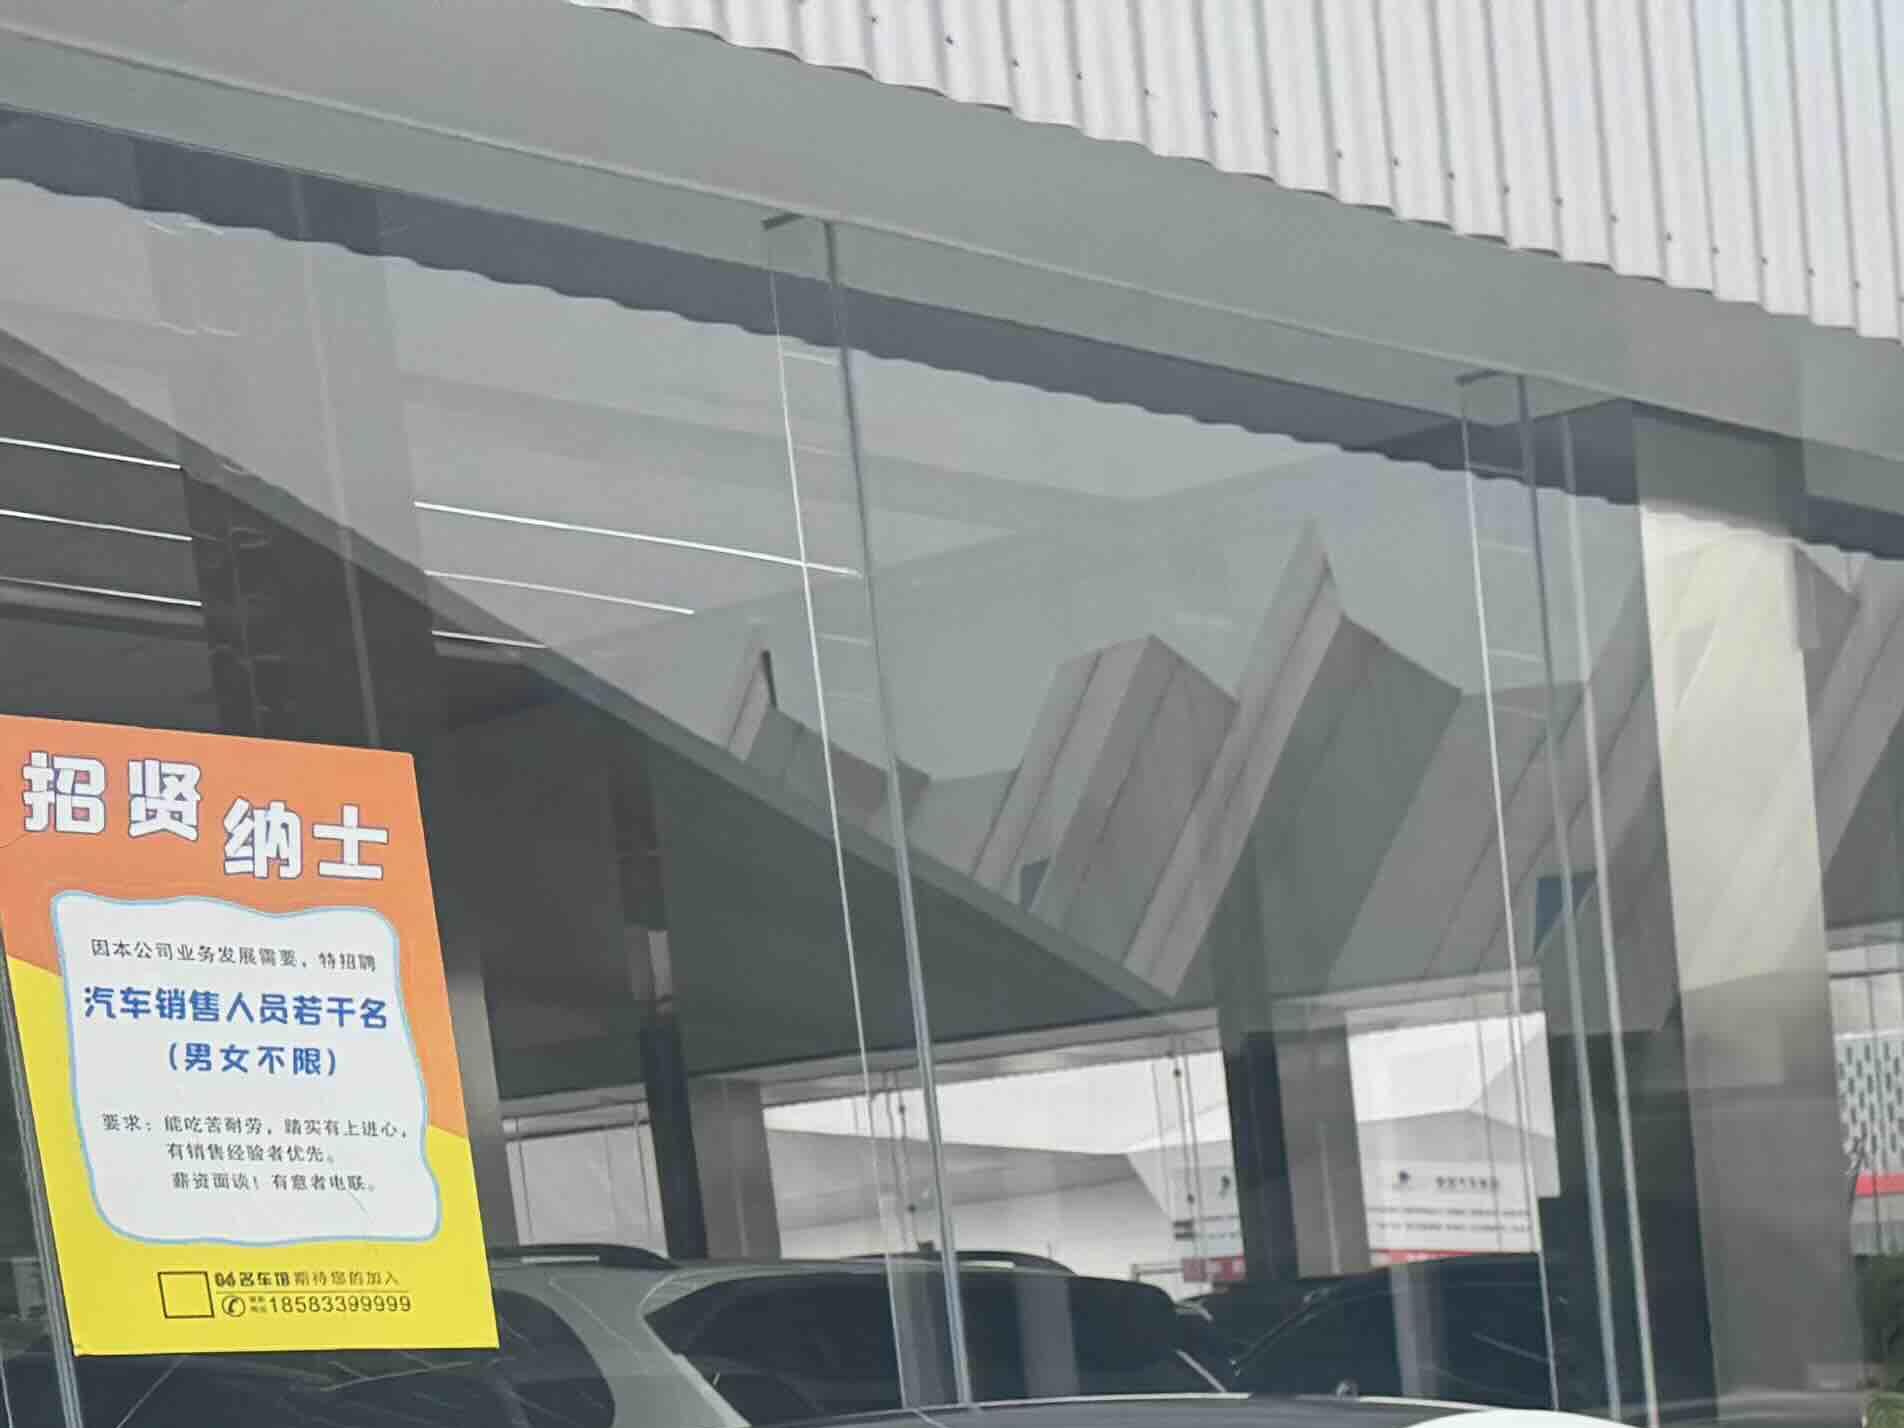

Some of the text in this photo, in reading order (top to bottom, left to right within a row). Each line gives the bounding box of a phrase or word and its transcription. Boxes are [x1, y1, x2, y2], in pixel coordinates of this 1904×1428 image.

[22, 750, 391, 881] 招贤纳士
[83, 985, 388, 1030] 汽车销售人员若干名
[269, 1295, 412, 1314] 18583399999
